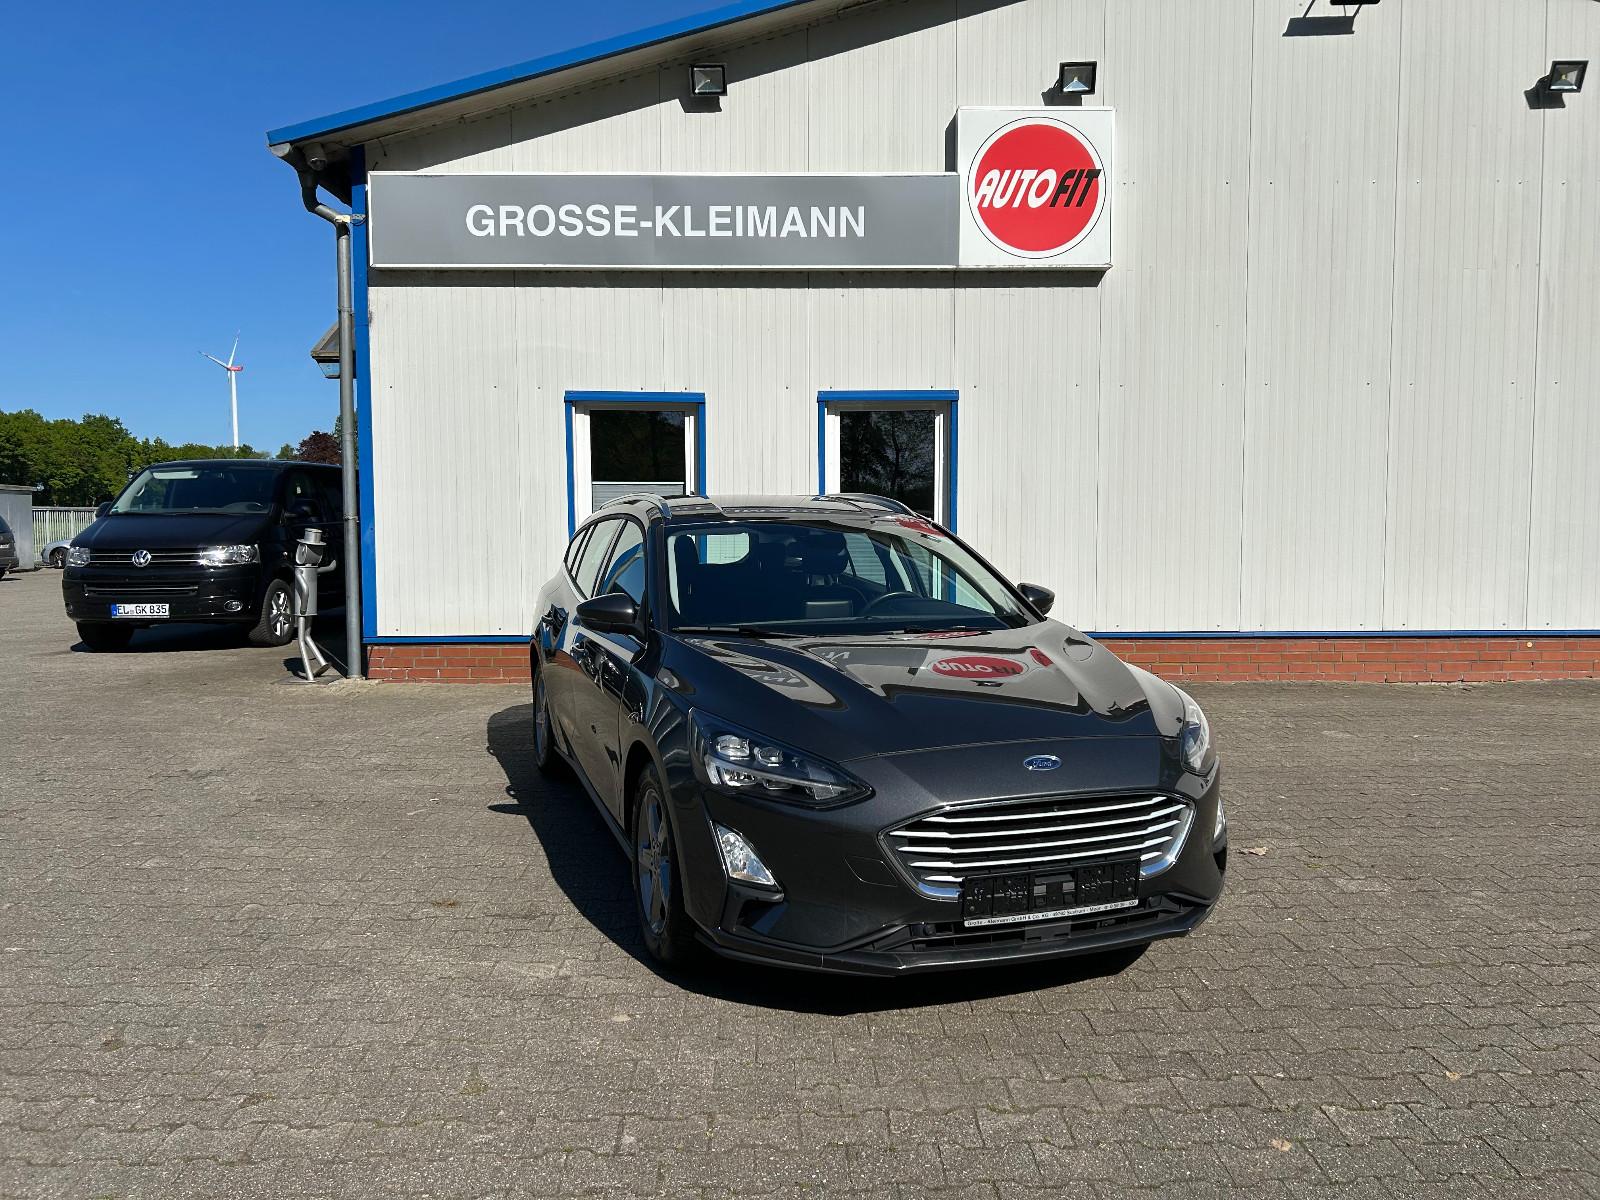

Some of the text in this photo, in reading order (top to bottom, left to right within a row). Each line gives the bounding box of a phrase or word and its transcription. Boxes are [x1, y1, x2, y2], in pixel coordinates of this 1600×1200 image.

[975, 168, 1102, 209] AUTOFIT
[465, 203, 866, 238] GROSSE-KLEIMANN
[149, 605, 167, 614] 835
